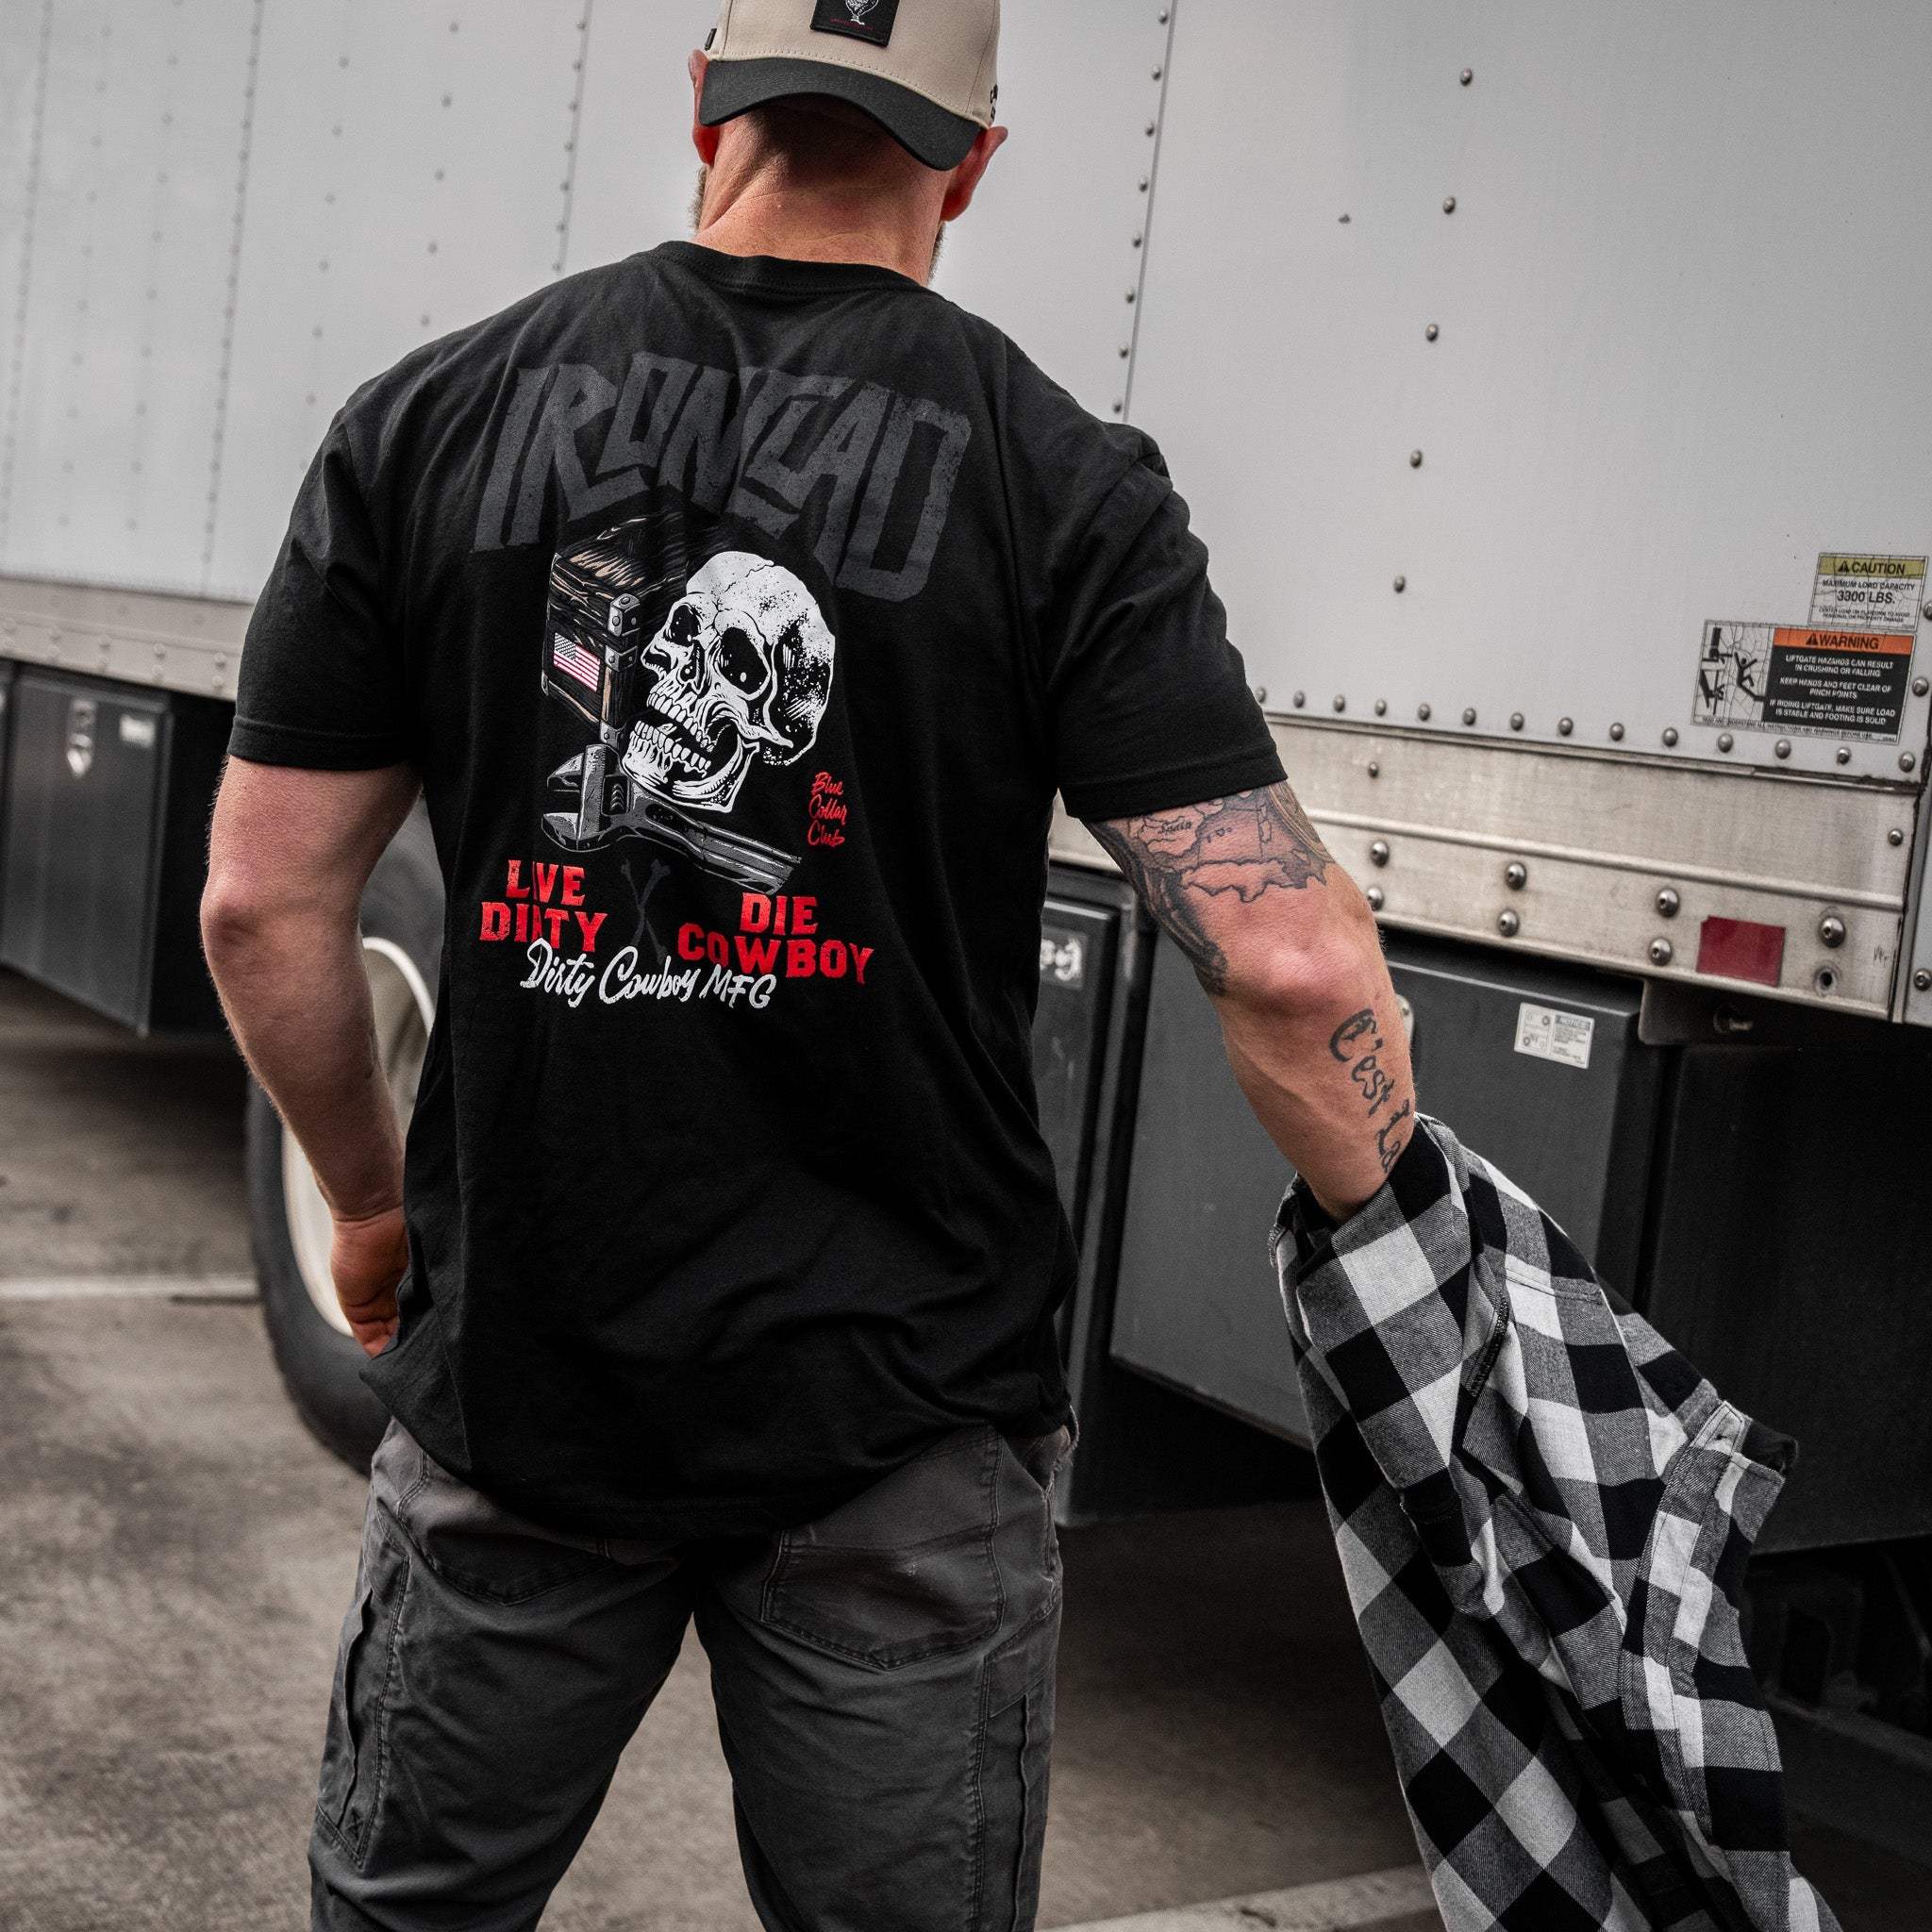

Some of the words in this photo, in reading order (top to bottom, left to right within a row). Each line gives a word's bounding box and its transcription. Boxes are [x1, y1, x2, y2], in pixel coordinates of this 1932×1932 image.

[470, 352, 972, 603] IRONCLAD
[1851, 561, 1906, 575] CAUTION
[1880, 582, 1915, 591] CAPACITY
[1837, 591, 1865, 602] 3300
[1868, 591, 1895, 604] LBS.
[1819, 634, 1879, 649] WARNING
[1785, 655, 1817, 663] LIFTGATE
[1818, 657, 1849, 665] HAZARDS
[1851, 658, 1866, 667] CAN
[1867, 660, 1894, 669] RESULT
[1803, 665, 1839, 674] CRUSHING
[1852, 668, 1881, 676] FALLING
[1799, 678, 1822, 687] HANDS
[1824, 680, 1838, 689] AND
[1857, 683, 1880, 691] CLEAR
[1832, 691, 1857, 699] POINTS
[1783, 709, 1807, 718] STABLE
[1824, 712, 1855, 722] FOOTING
[1865, 716, 1887, 724] SOLID
[1835, 705, 1855, 713] MAKE
[1857, 706, 1874, 715] SURE
[1875, 708, 1895, 717] LOAD
[811, 772, 843, 795] Blue
[808, 794, 847, 825] Collar
[506, 859, 586, 907] LVE
[740, 891, 819, 936] DIE
[677, 922, 874, 985] COWBOY
[520, 937, 595, 1008] Dirty
[598, 945, 702, 1005] Cowboy
[699, 963, 777, 1009] MFG
